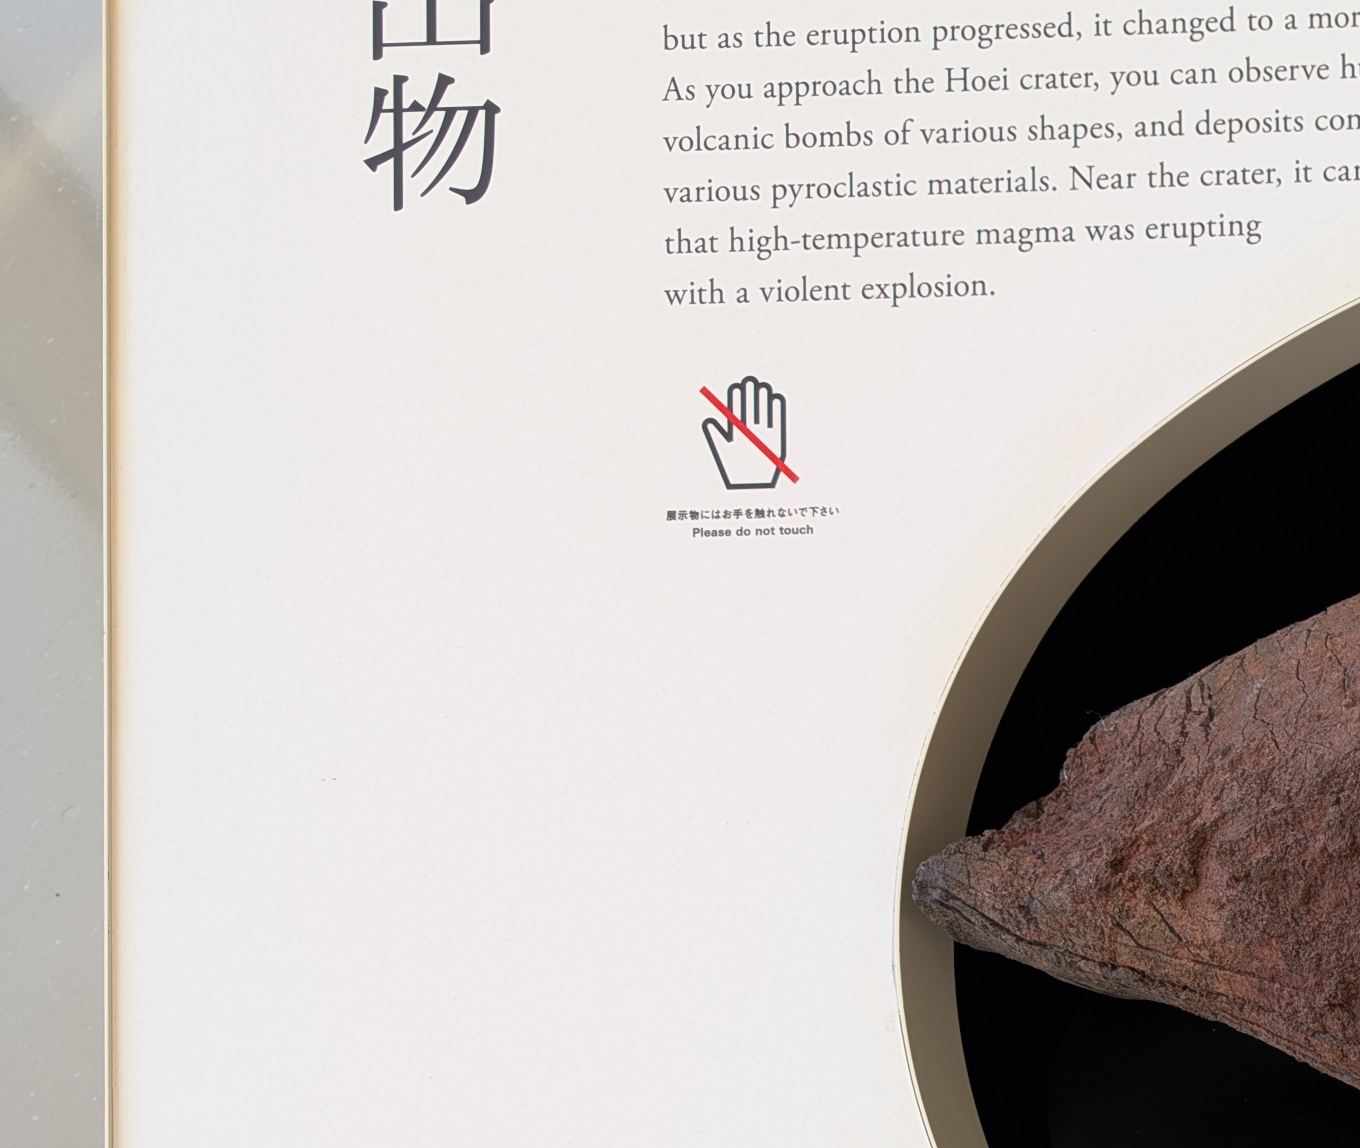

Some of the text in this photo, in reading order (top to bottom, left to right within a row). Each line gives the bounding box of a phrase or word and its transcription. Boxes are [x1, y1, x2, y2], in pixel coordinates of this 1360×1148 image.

[662, 76, 695, 101] As
[705, 83, 753, 108] you
[764, 69, 883, 106] approach
[894, 67, 934, 94] the
[945, 67, 1009, 92] Hoei
[1020, 72, 1099, 91] crater,
[1110, 70, 1159, 95] you
[1170, 68, 1217, 85] can
[1229, 56, 1329, 83] observe
[665, 213, 1261, 260] that high-temperature magma was erupting
[664, 272, 995, 307] with a violent explosion.
[666, 506, 839, 521] 展示物にはお手を触れないで下さい
[693, 524, 813, 537] Please do not touch
